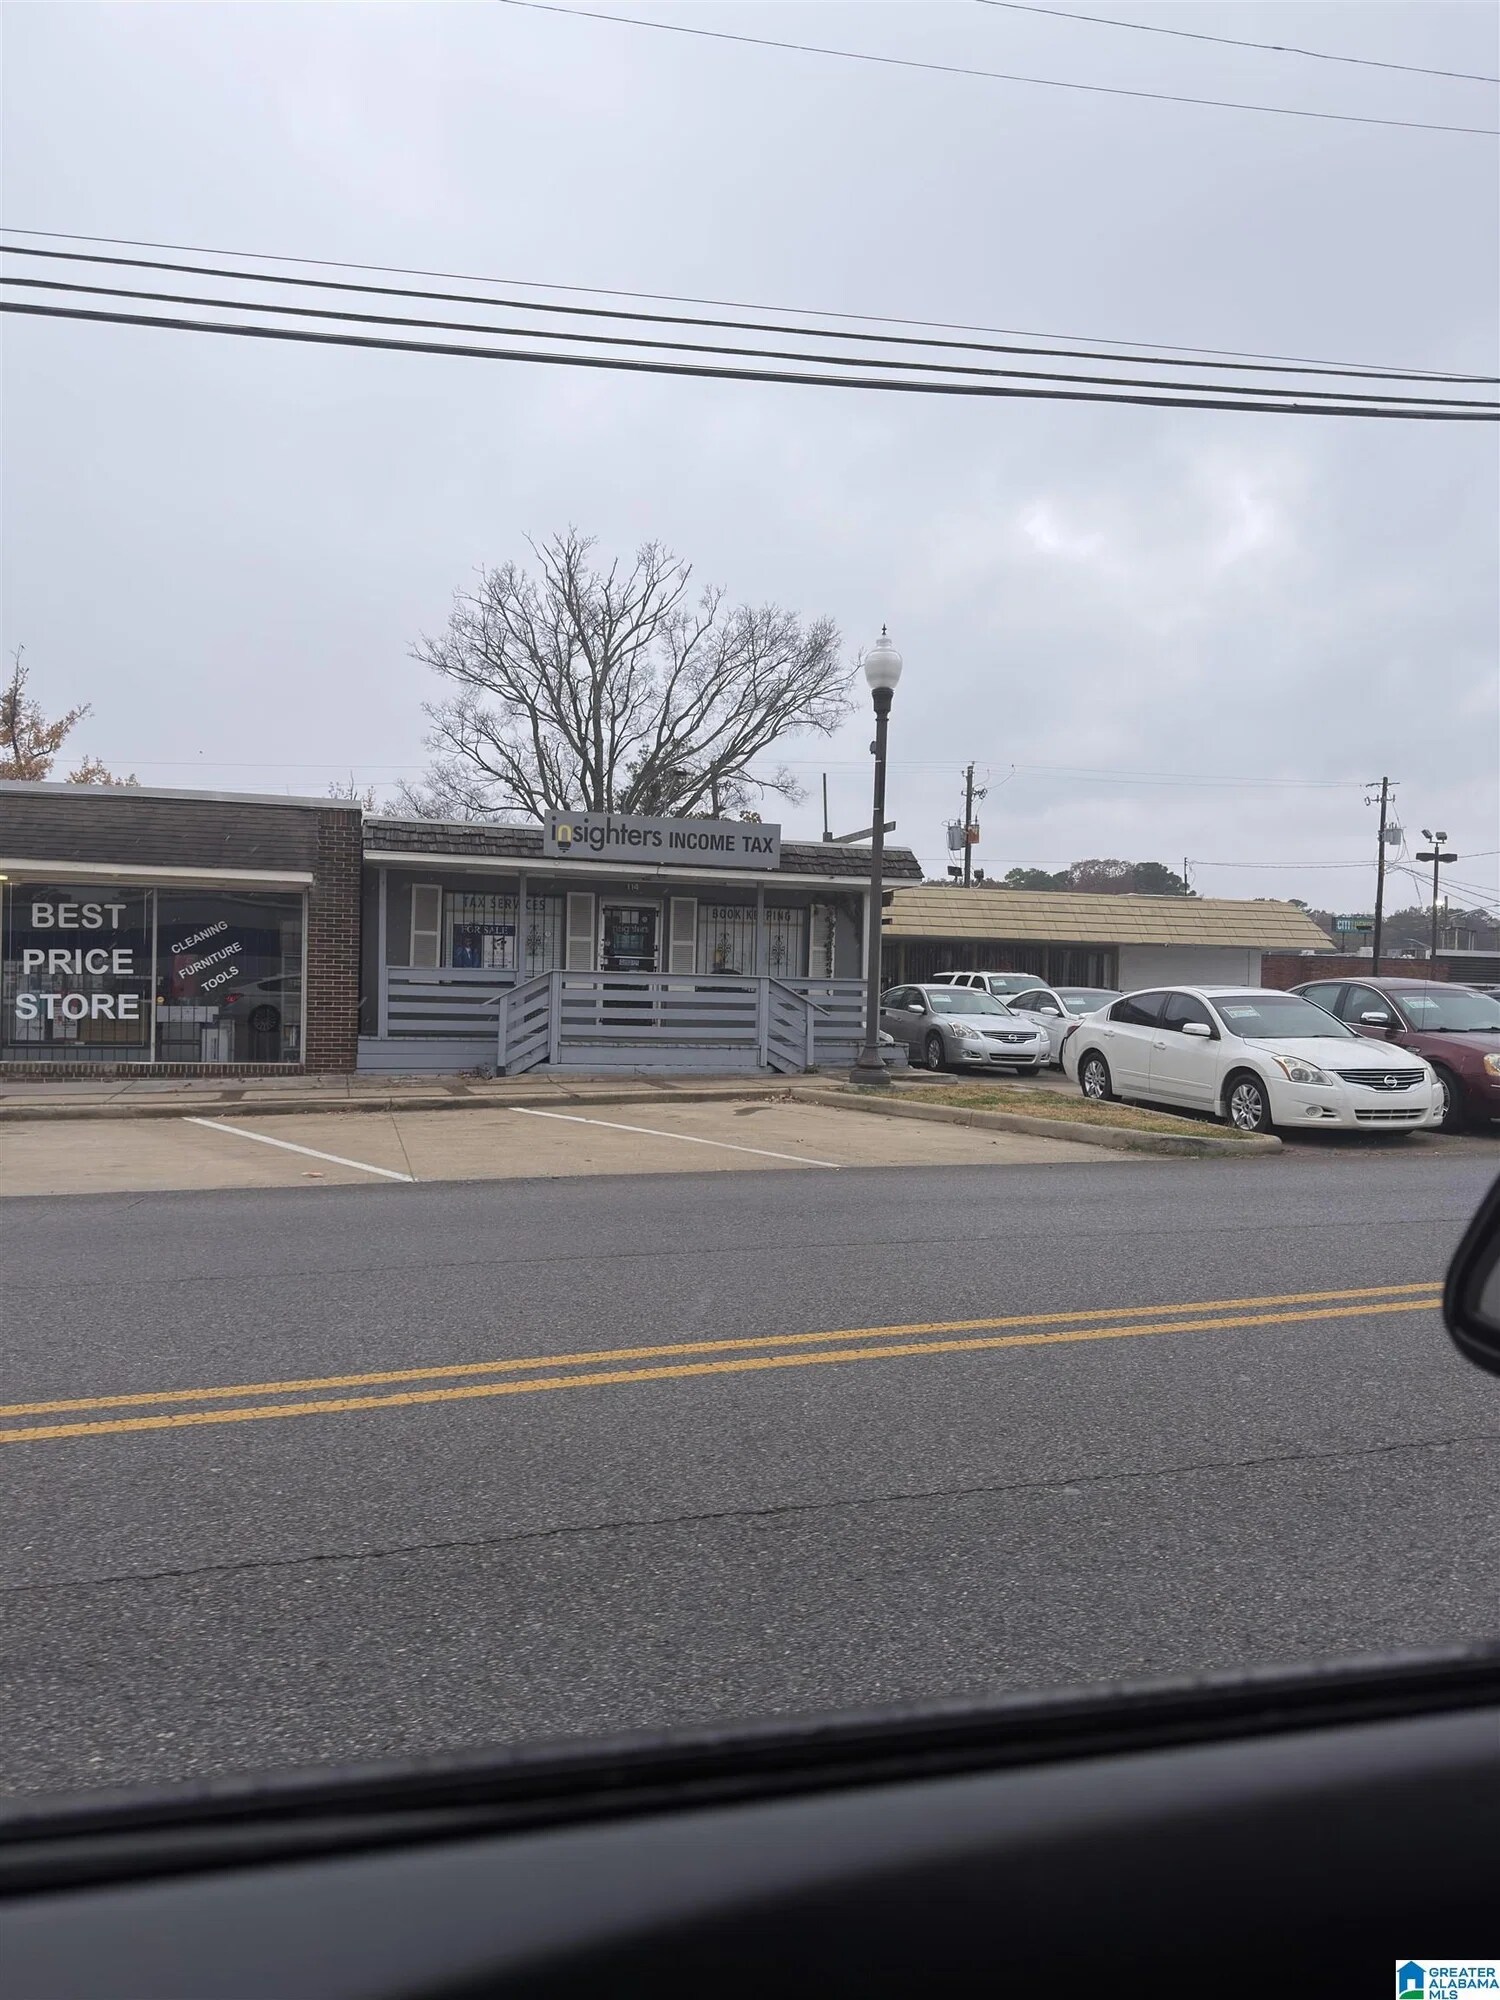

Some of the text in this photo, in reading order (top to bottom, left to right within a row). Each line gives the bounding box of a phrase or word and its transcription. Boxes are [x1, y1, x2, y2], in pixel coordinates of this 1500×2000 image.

[551, 816, 774, 854] insighters INCOME TAX
[31, 903, 127, 929] BEST
[463, 896, 546, 911] TAX SERVCES
[712, 907, 791, 922] BOOK KEPING
[171, 920, 229, 954] CLEANING
[461, 923, 509, 935] FOR SALE
[23, 948, 134, 975] PRICE
[178, 941, 243, 979] FURNITURE
[201, 965, 240, 992] TOOLS
[15, 993, 140, 1020] STORE
